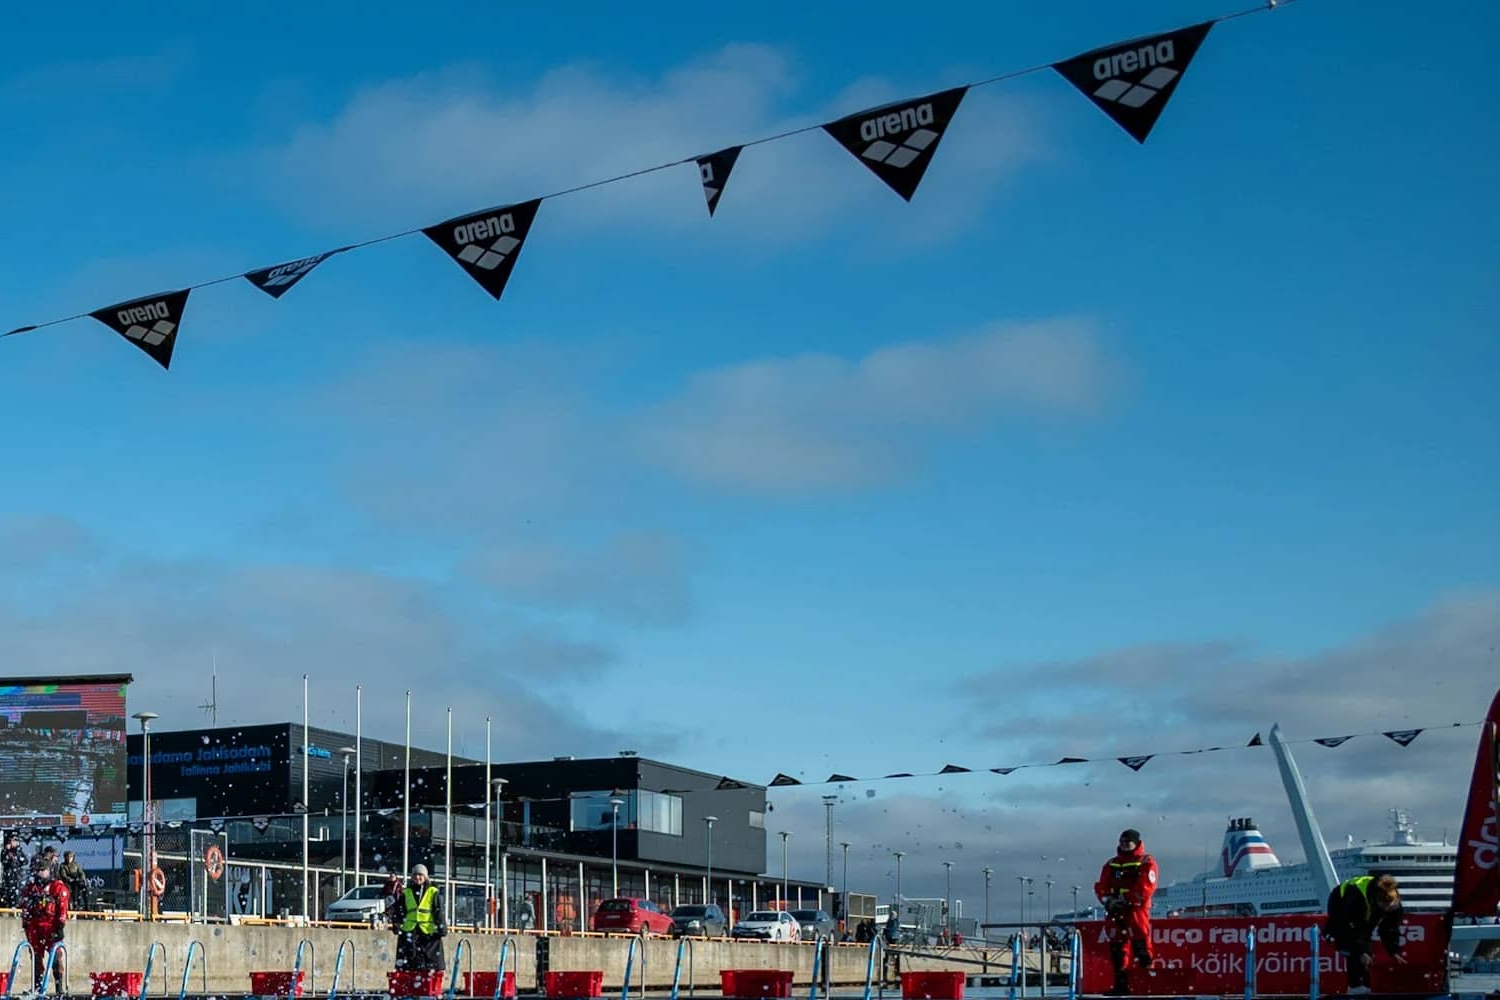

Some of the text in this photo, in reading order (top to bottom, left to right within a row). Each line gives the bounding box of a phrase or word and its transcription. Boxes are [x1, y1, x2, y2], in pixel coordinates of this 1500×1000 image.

[1092, 39, 1175, 81] arena
[860, 102, 934, 142] arena
[453, 212, 516, 245] arena
[117, 300, 171, 326] arena
[1191, 952, 1243, 975] kõik
